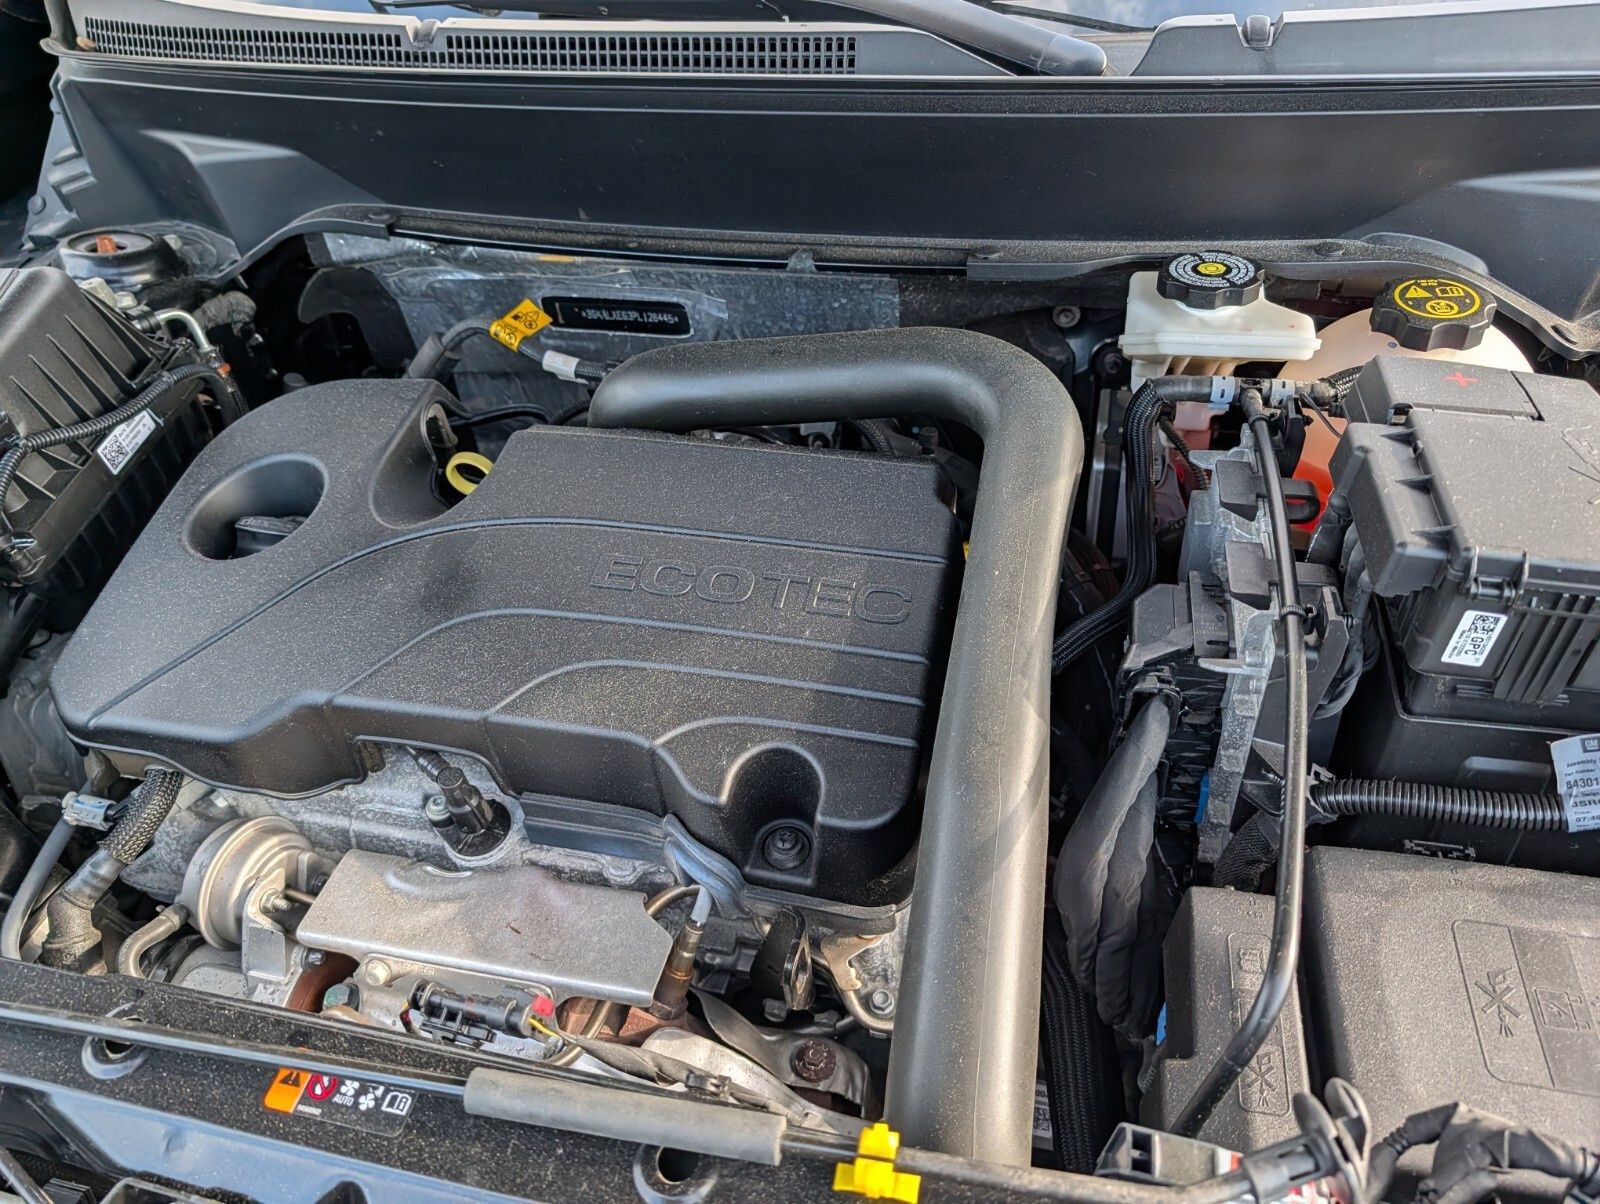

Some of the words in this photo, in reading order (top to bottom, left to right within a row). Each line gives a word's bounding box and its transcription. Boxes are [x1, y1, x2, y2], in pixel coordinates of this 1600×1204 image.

[590, 553, 913, 624] ECOTEC
[1464, 637, 1485, 656] GPC
[1584, 740, 1599, 751] GM
[1566, 759, 1597, 768] Assembly
[332, 1094, 354, 1107] AUTO
